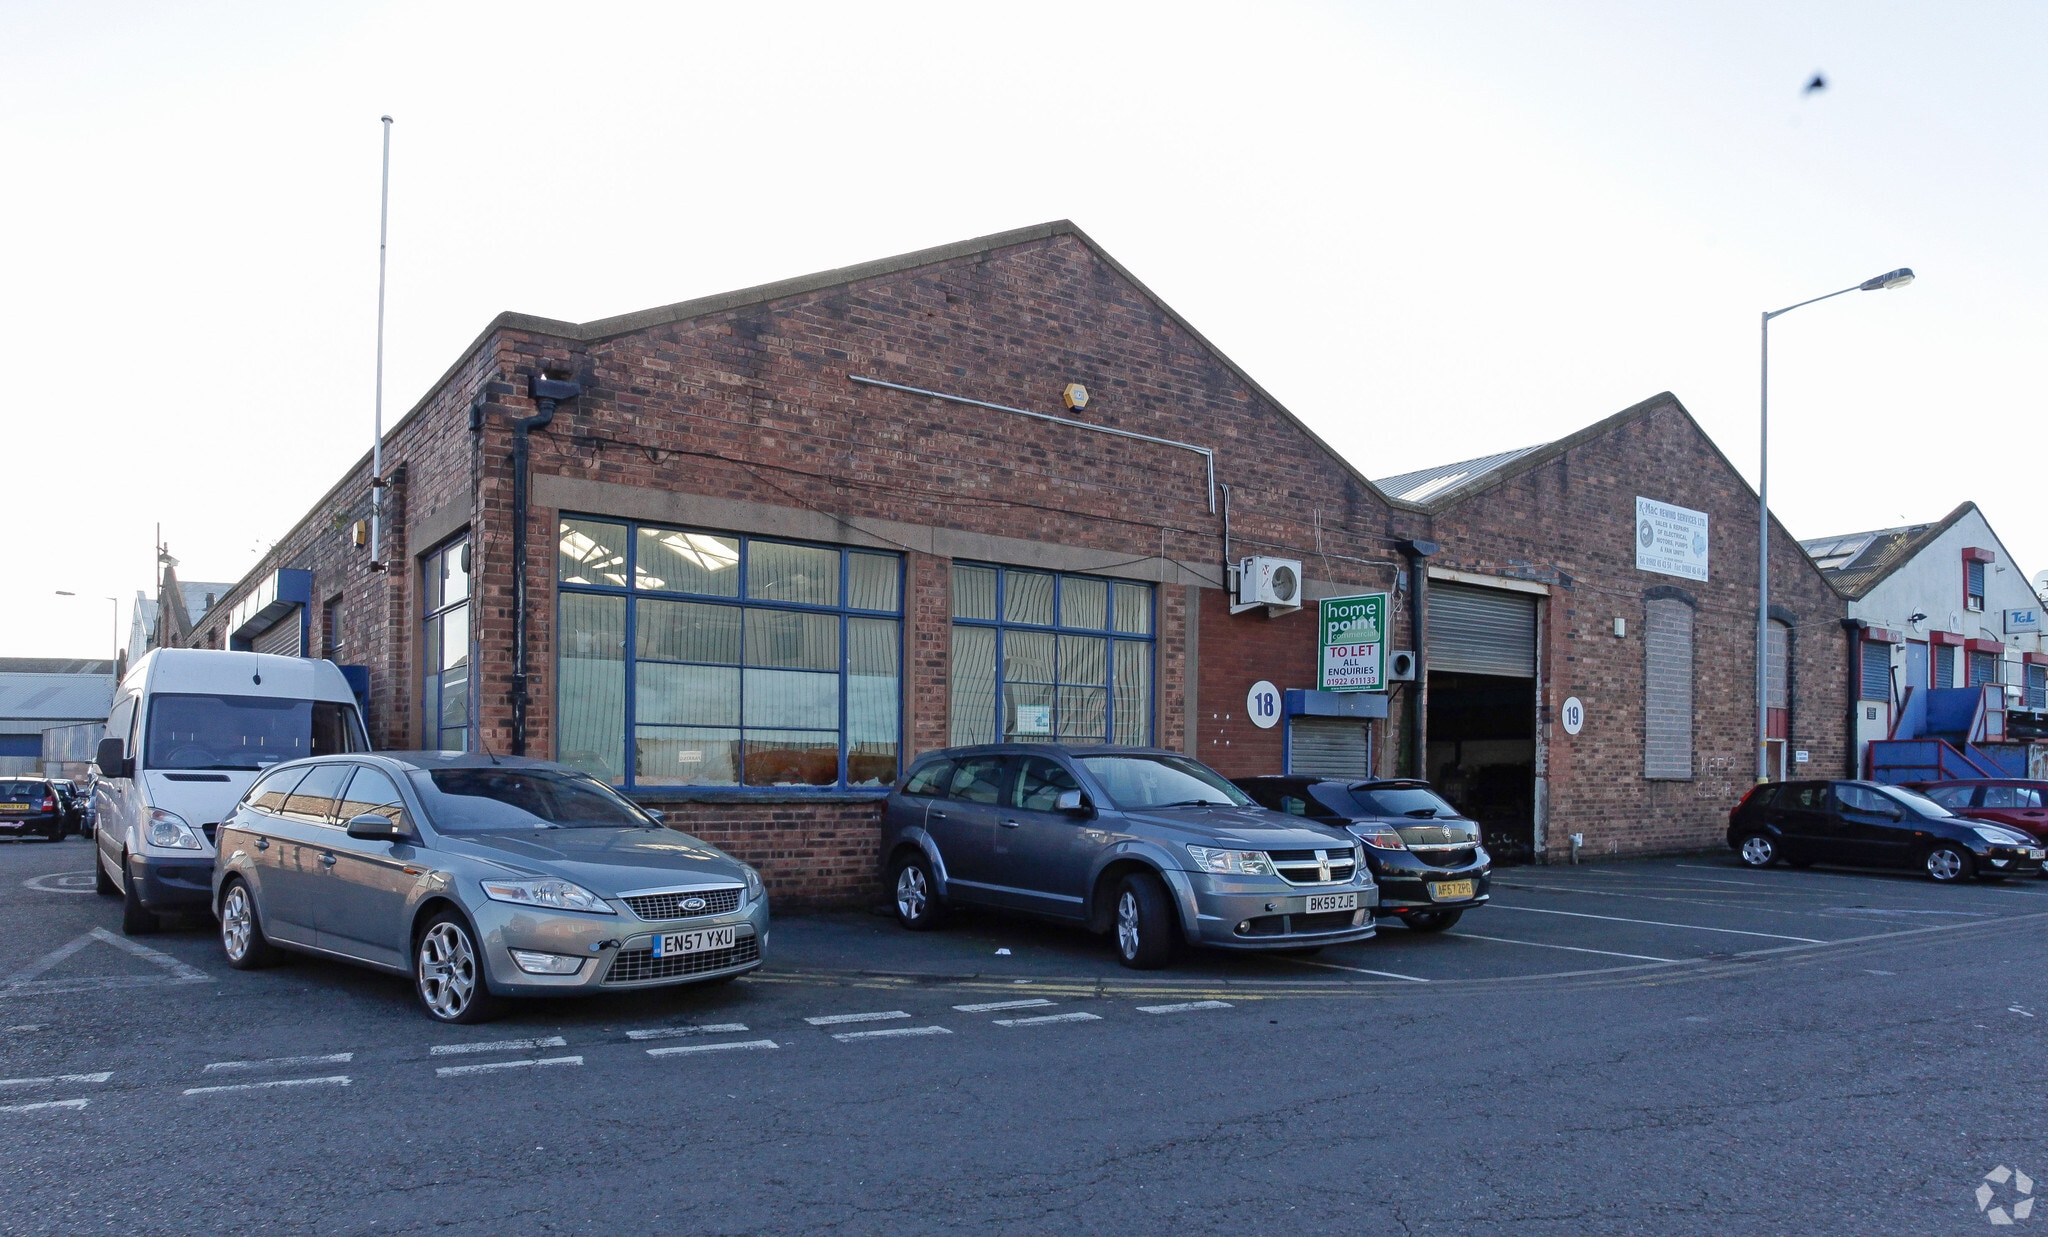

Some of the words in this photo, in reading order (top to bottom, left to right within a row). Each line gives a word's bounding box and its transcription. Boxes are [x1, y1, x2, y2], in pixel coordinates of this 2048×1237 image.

[1677, 512, 1697, 525] SERVICES
[1664, 530, 1687, 541] ELECTRICAL
[1328, 603, 1376, 618] home
[1328, 616, 1376, 645] point
[1332, 631, 1376, 640] commercial
[1330, 646, 1347, 658] TO
[1351, 645, 1374, 657] LET
[1328, 666, 1374, 676] ENQUIRIES
[1254, 692, 1274, 717] 18
[1567, 706, 1579, 725] 19
[1698, 782, 1732, 797] CLEAR
[1438, 884, 1456, 896] AF57
[1310, 896, 1336, 910] BK59
[1338, 895, 1354, 908] ZJE
[664, 933, 702, 953] EN57
[707, 929, 733, 947] YXU
